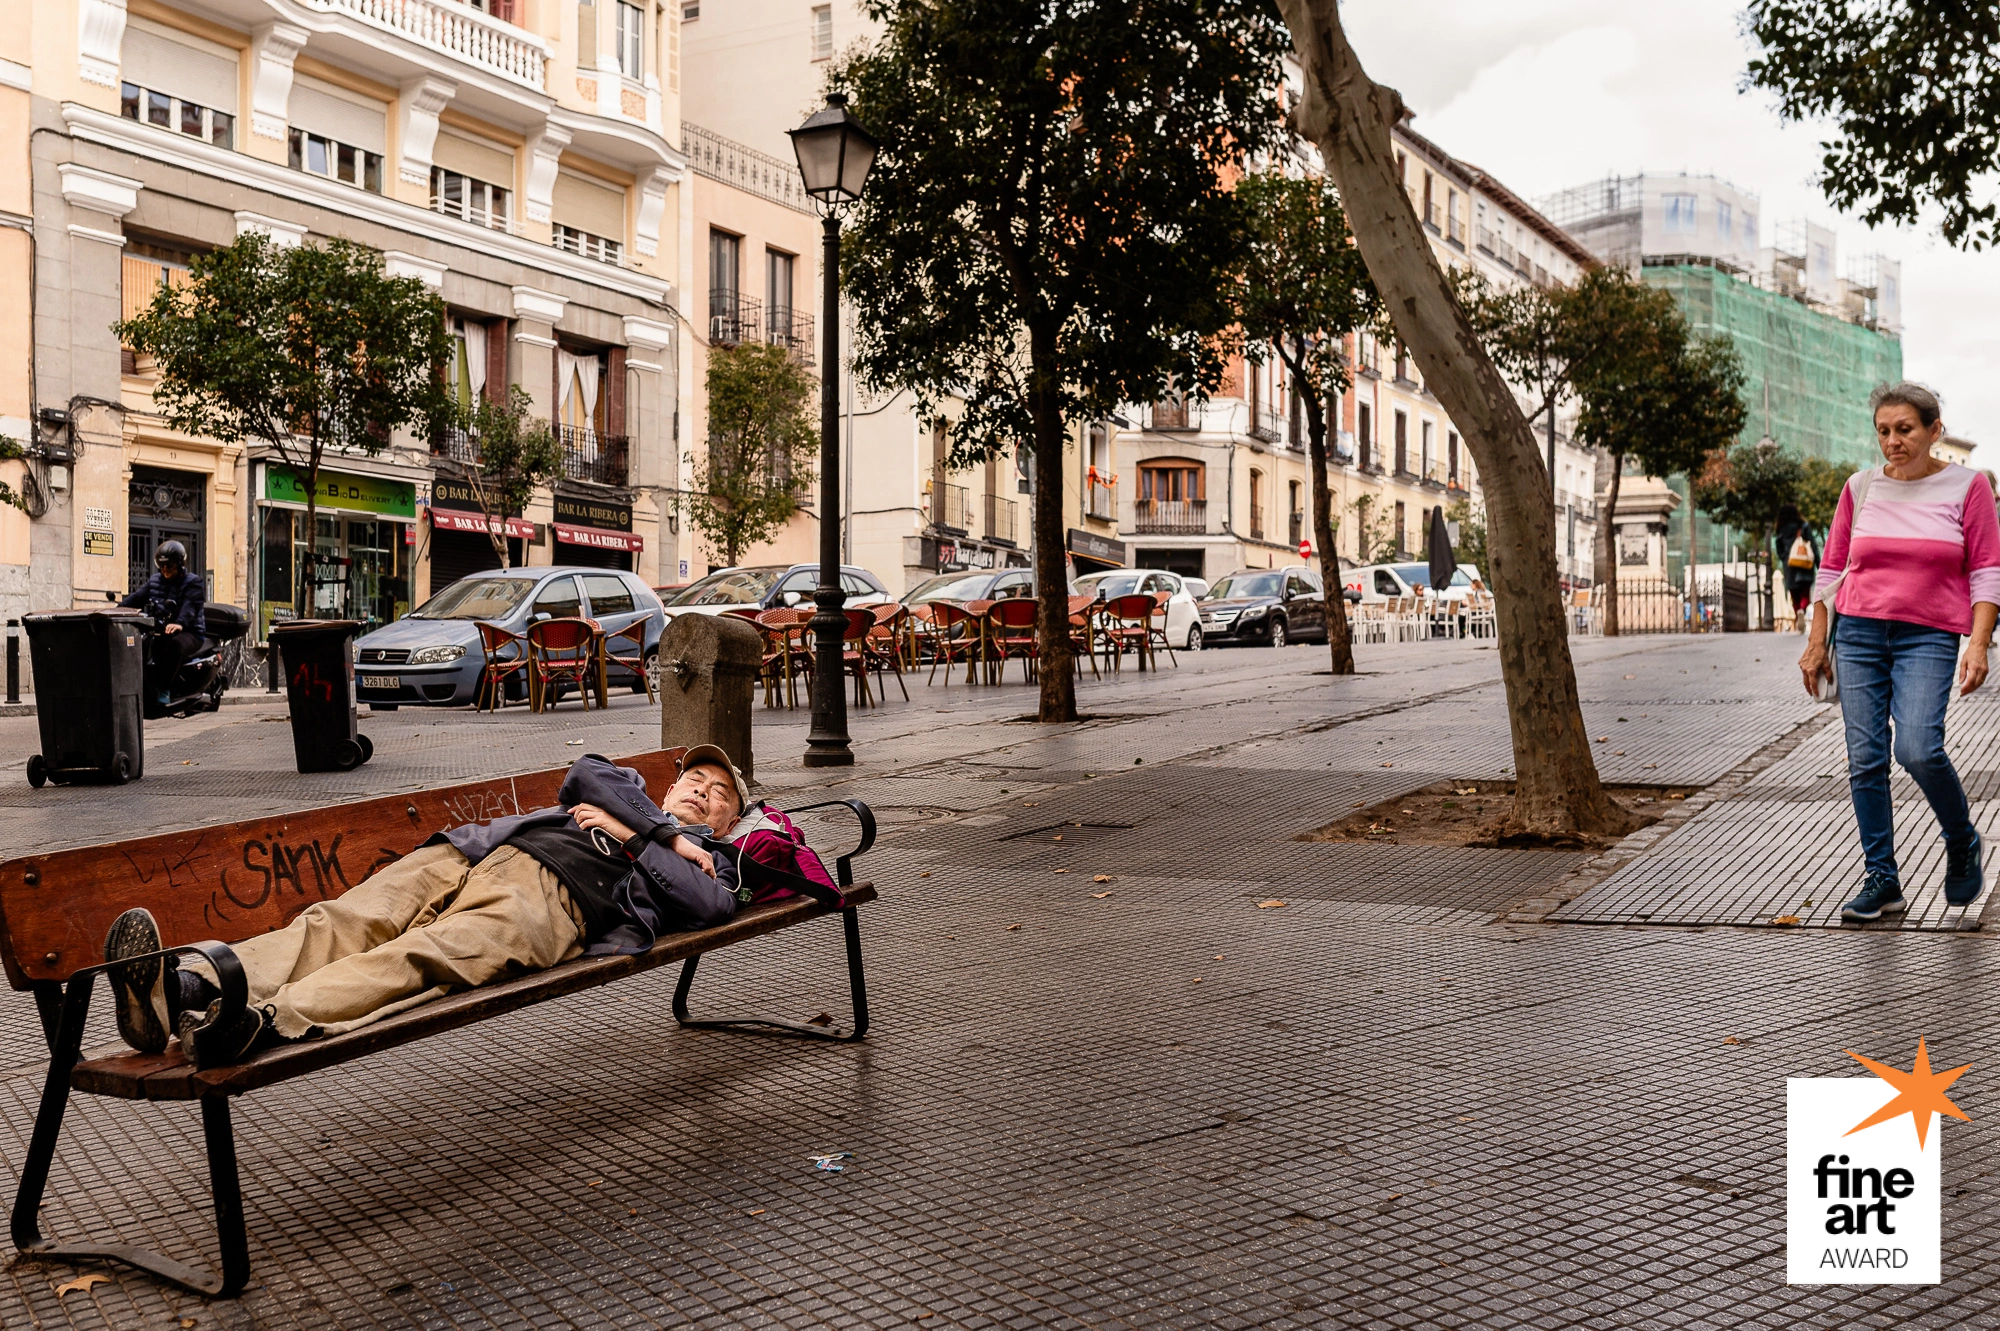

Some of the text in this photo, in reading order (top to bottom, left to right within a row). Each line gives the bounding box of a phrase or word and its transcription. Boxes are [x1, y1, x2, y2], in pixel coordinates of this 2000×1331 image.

[158, 492, 167, 503] 13
[449, 486, 468, 500] BAR
[557, 502, 575, 514] BAR
[576, 505, 588, 517] LA
[589, 507, 618, 521] RIBERA
[453, 517, 474, 530] BAR
[474, 520, 488, 531] LA
[85, 532, 112, 541] SE VENDE
[573, 531, 590, 543] BAR
[590, 534, 601, 545] LA
[601, 536, 629, 549] RIBERA
[364, 677, 381, 687] 3261
